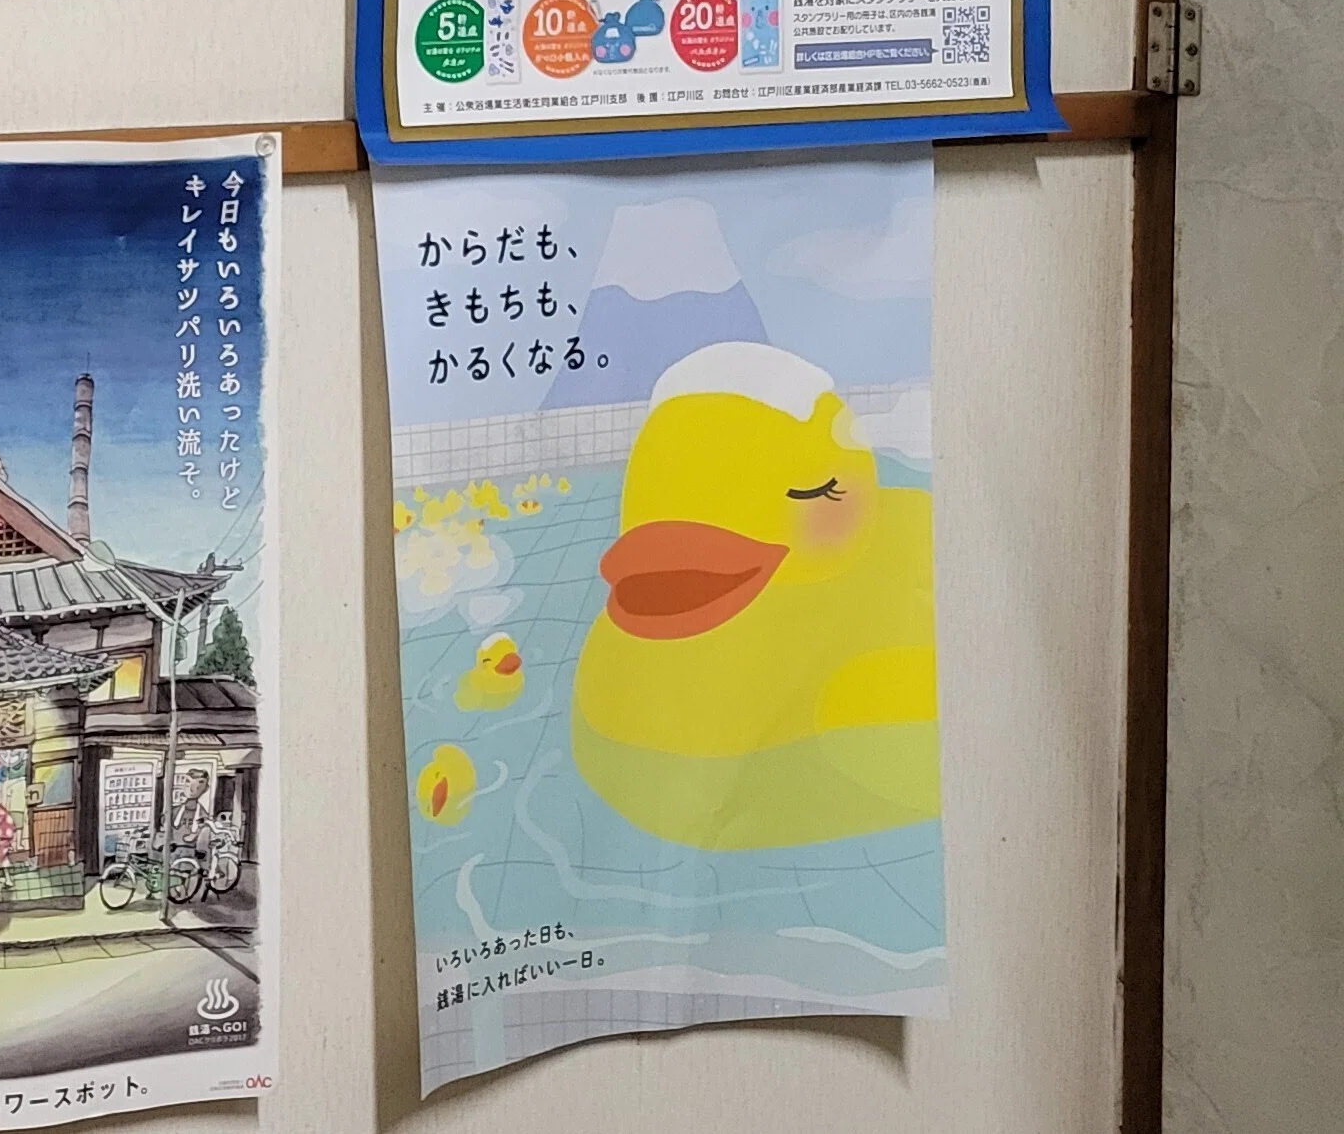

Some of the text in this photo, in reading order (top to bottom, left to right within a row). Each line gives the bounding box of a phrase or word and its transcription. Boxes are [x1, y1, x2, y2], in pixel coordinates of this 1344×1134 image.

[417, 222, 579, 269] からだも、
[425, 280, 579, 328] きもちも、
[216, 169, 246, 511] 今日もいろいろあったけど
[427, 335, 610, 386] かるくなる。
[436, 921, 575, 974] いろいろあった日も、
[436, 950, 606, 1013] 銭湯に入ればいい一日。
